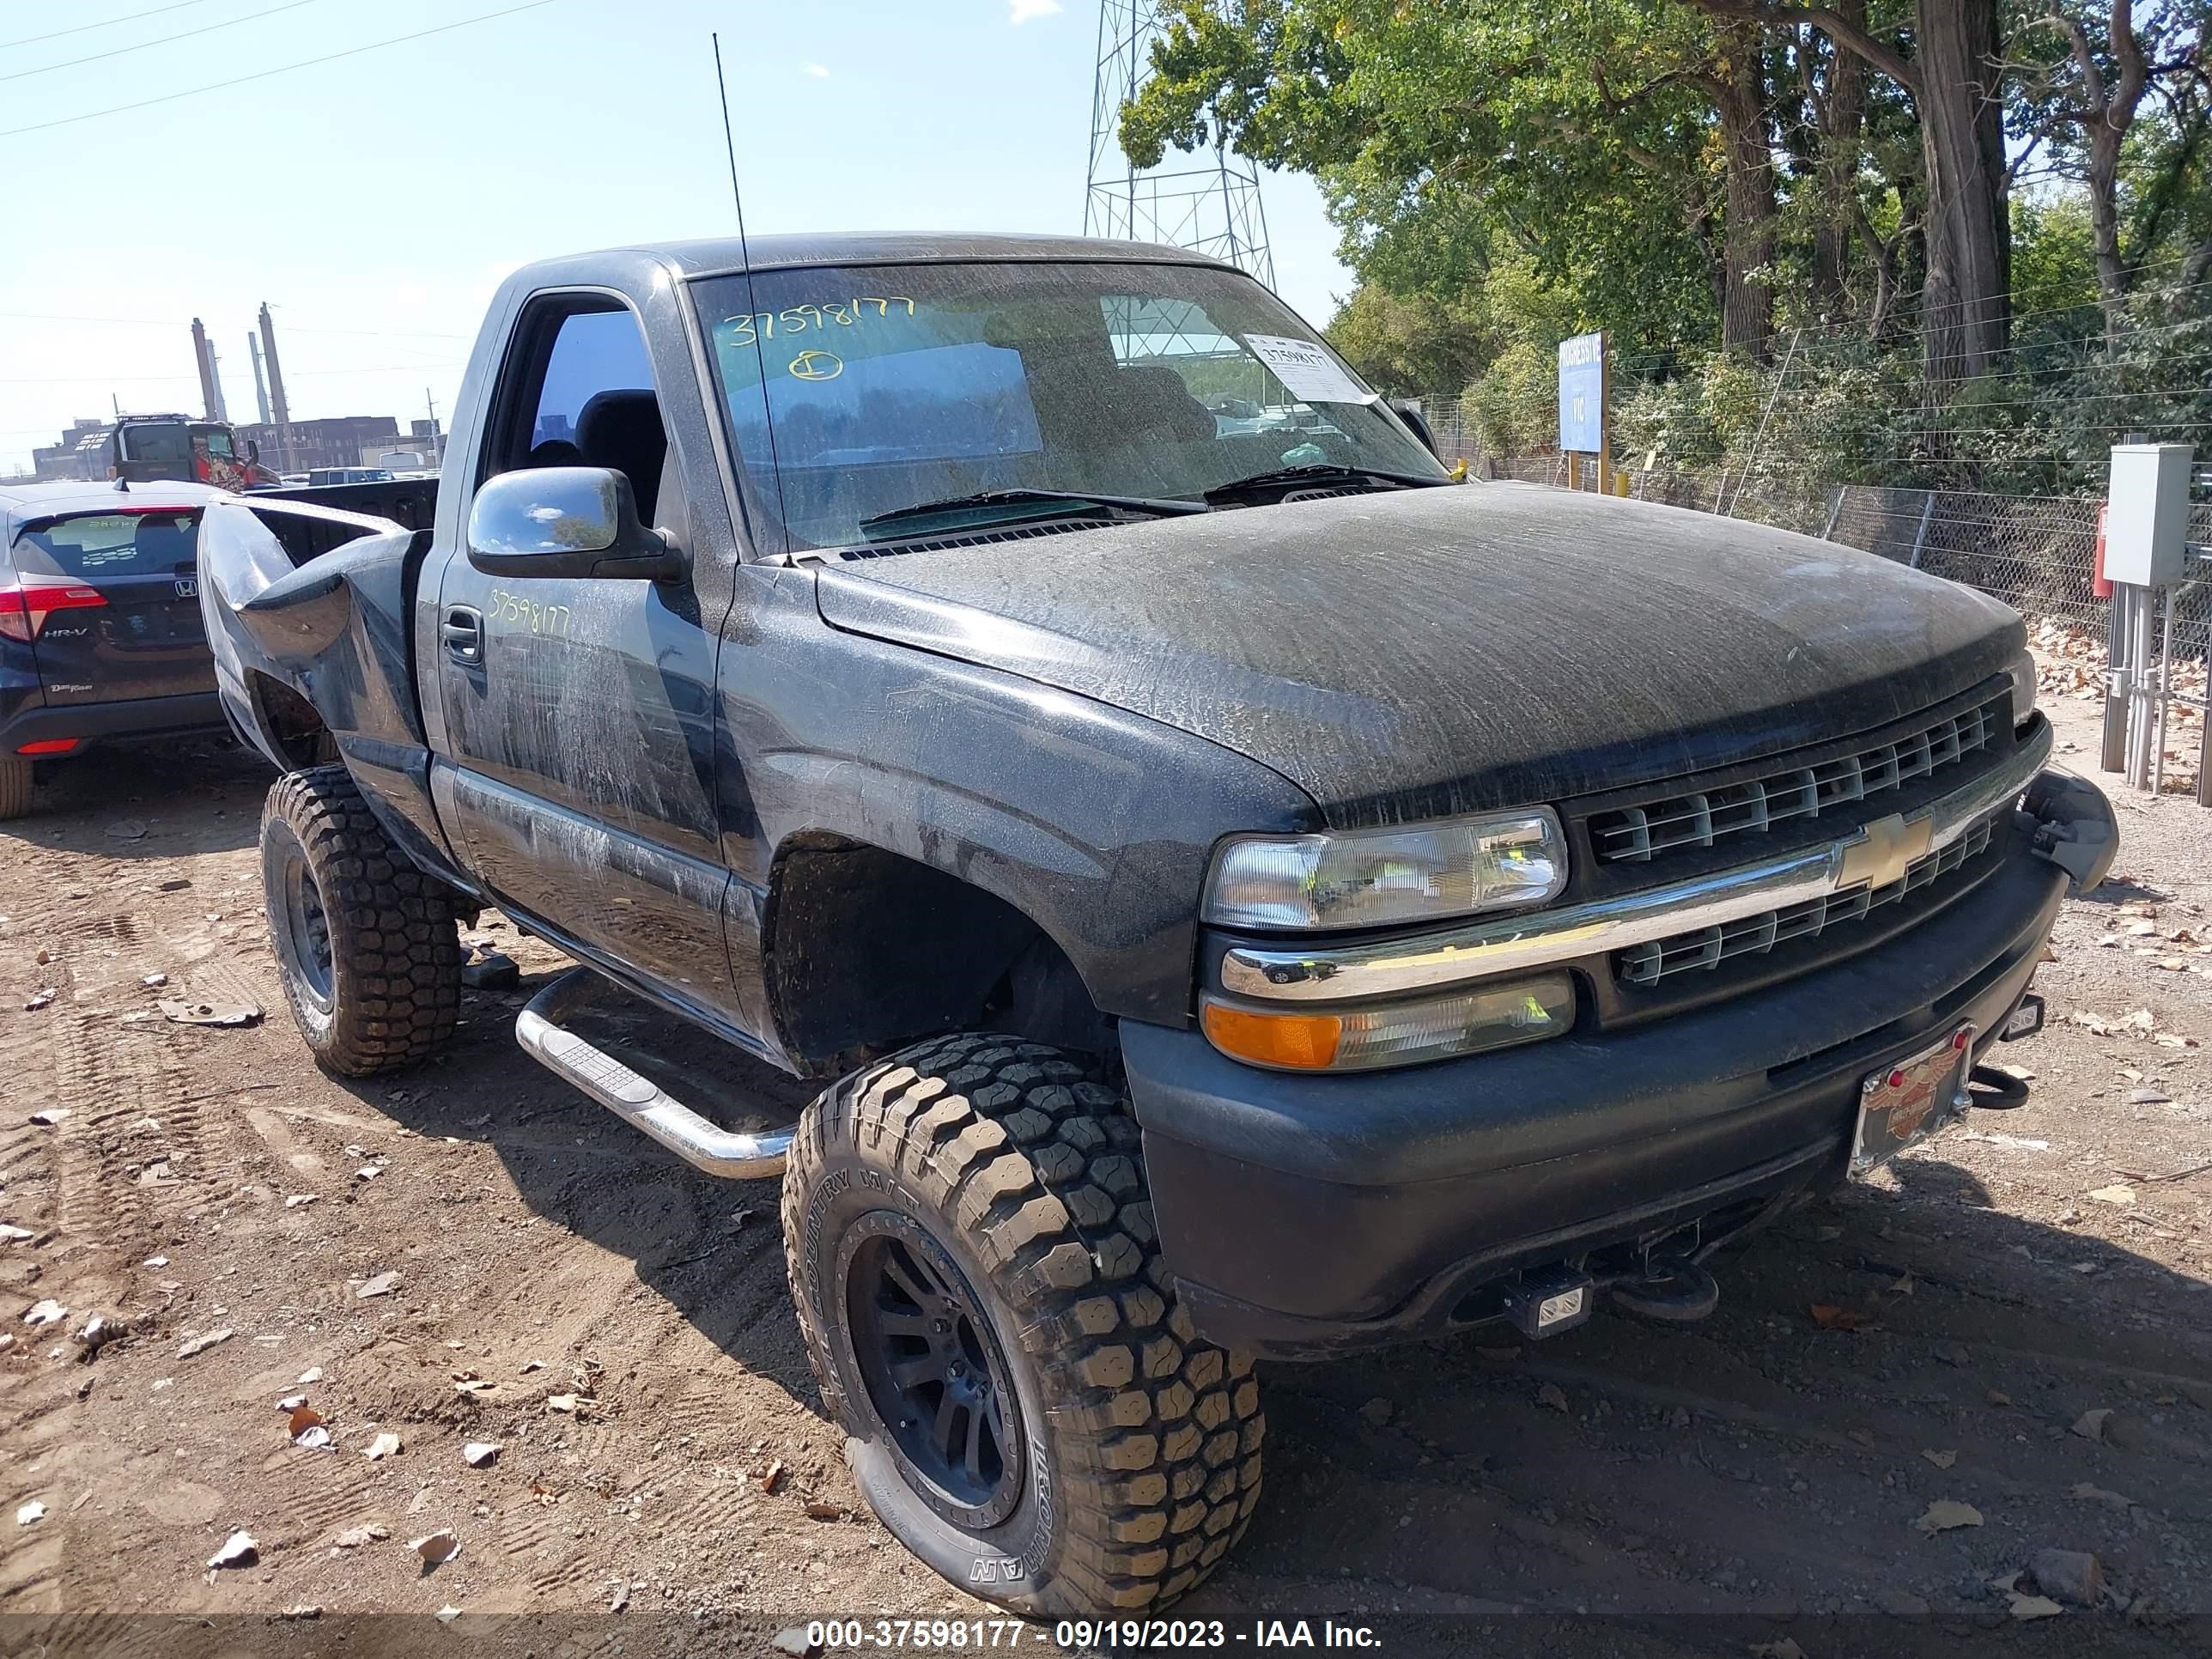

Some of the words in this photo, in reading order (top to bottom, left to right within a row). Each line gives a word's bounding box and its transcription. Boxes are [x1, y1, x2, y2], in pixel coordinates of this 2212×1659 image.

[724, 296, 915, 346] 37598177
[1263, 349, 1329, 368] 37598177
[45, 628, 88, 637] HR-V
[489, 589, 569, 635] 37598177
[805, 1167, 850, 1320] COUNTRY
[970, 1436, 1054, 1583] IRONMAN
